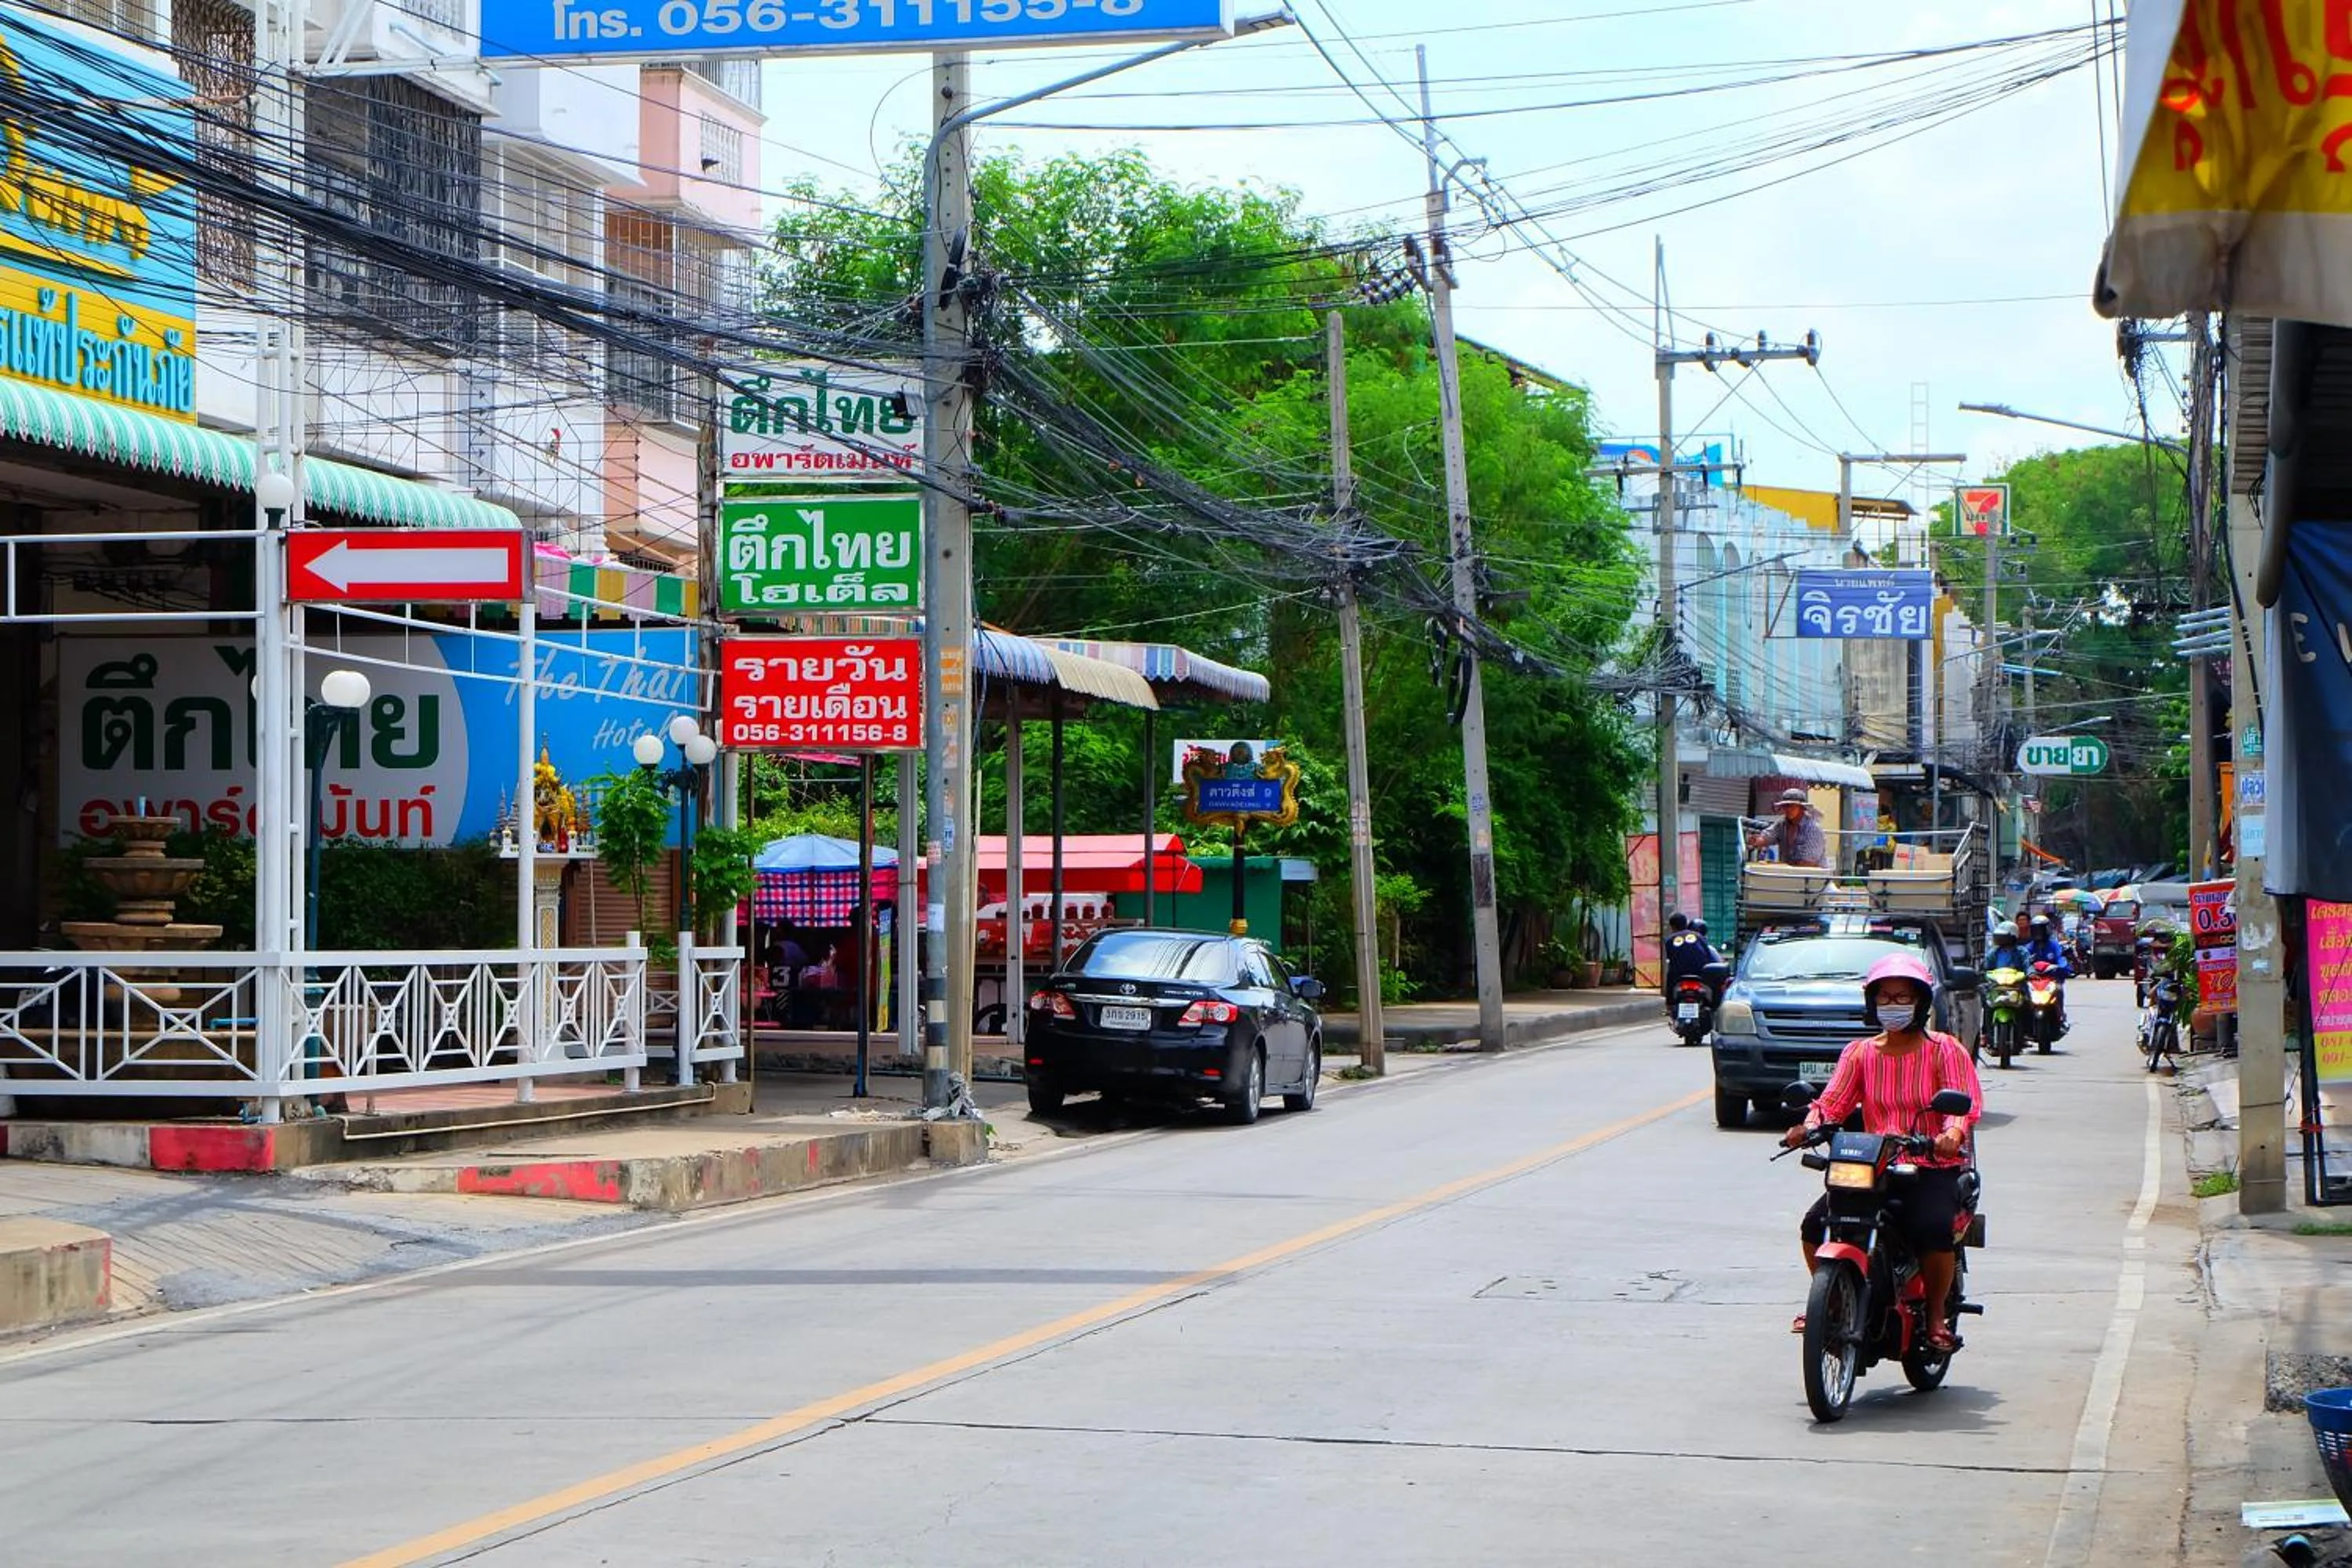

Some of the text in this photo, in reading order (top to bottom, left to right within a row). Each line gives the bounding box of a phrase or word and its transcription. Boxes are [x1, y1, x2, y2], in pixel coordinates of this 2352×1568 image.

[730, 368, 915, 434] ตึกไทย
[728, 510, 912, 571] ตึกไทย
[730, 572, 909, 604] โฮเต็ล
[1801, 590, 1926, 635] จิรชัย
[734, 645, 909, 682] รายวัน
[733, 683, 908, 720] รายเดือน
[733, 724, 908, 742] 056-311156-8
